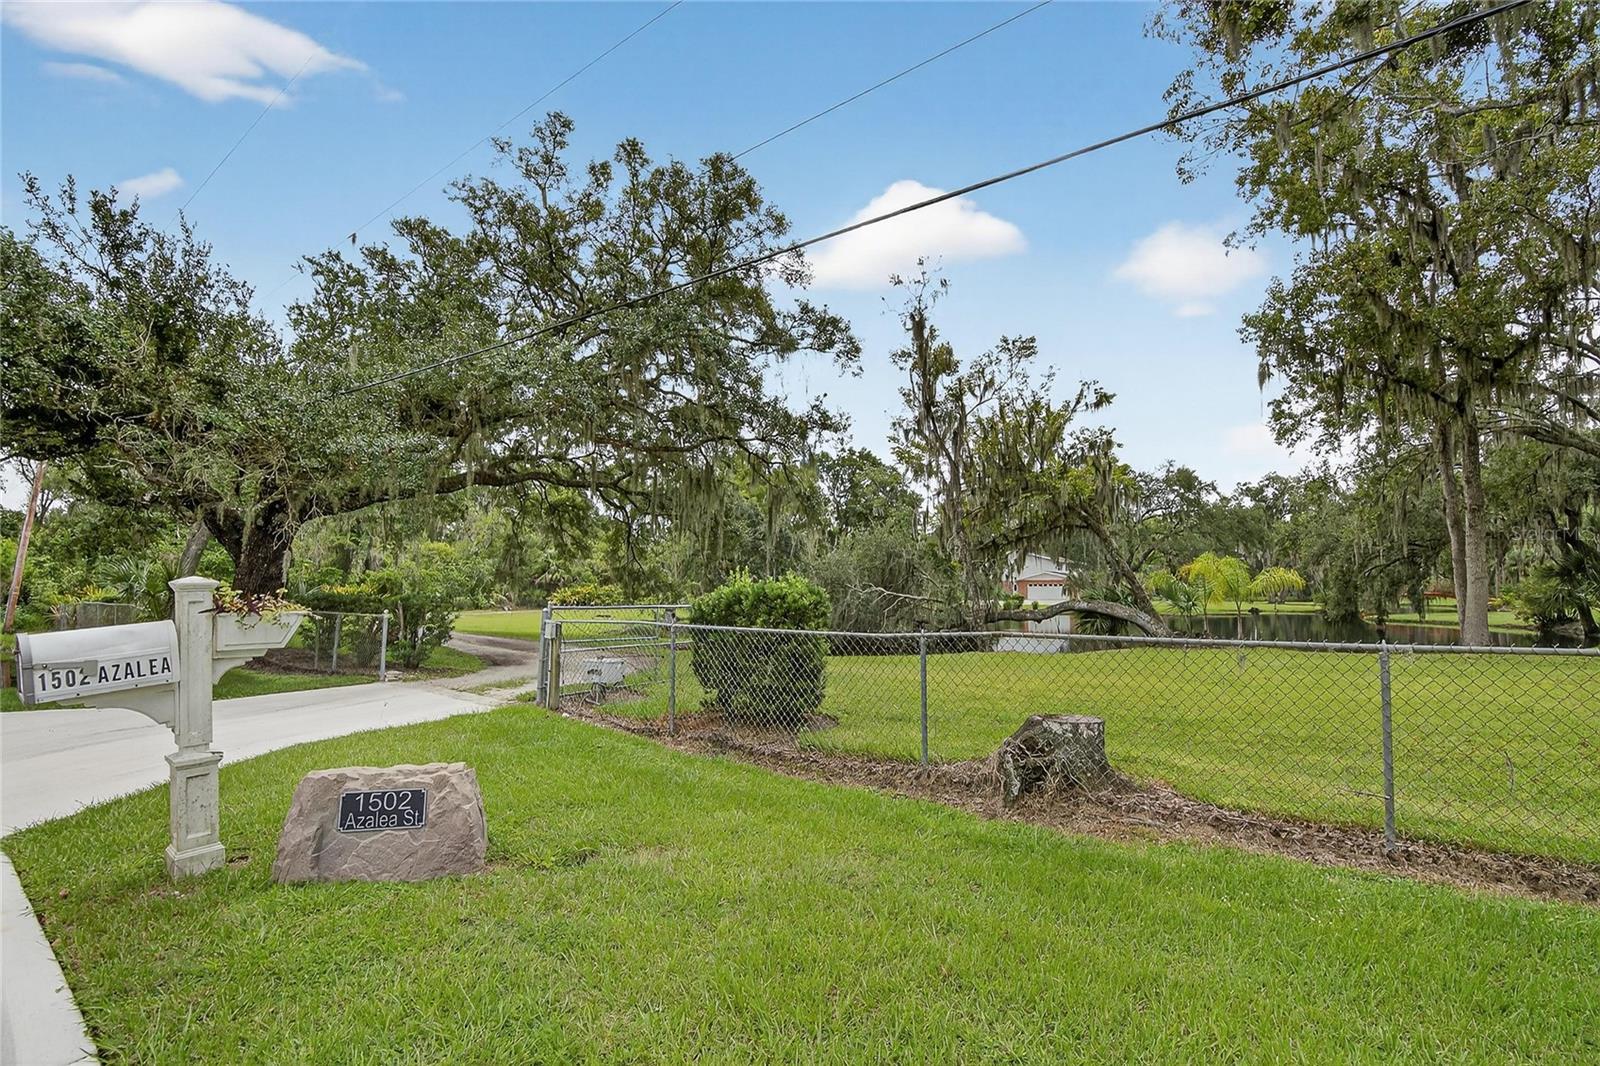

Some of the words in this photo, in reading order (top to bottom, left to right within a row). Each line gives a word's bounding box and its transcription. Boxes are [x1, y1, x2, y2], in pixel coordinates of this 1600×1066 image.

[98, 657, 172, 684] AZALEA
[355, 791, 412, 812] 1502
[345, 811, 398, 829] Azalea
[403, 809, 420, 827] St
